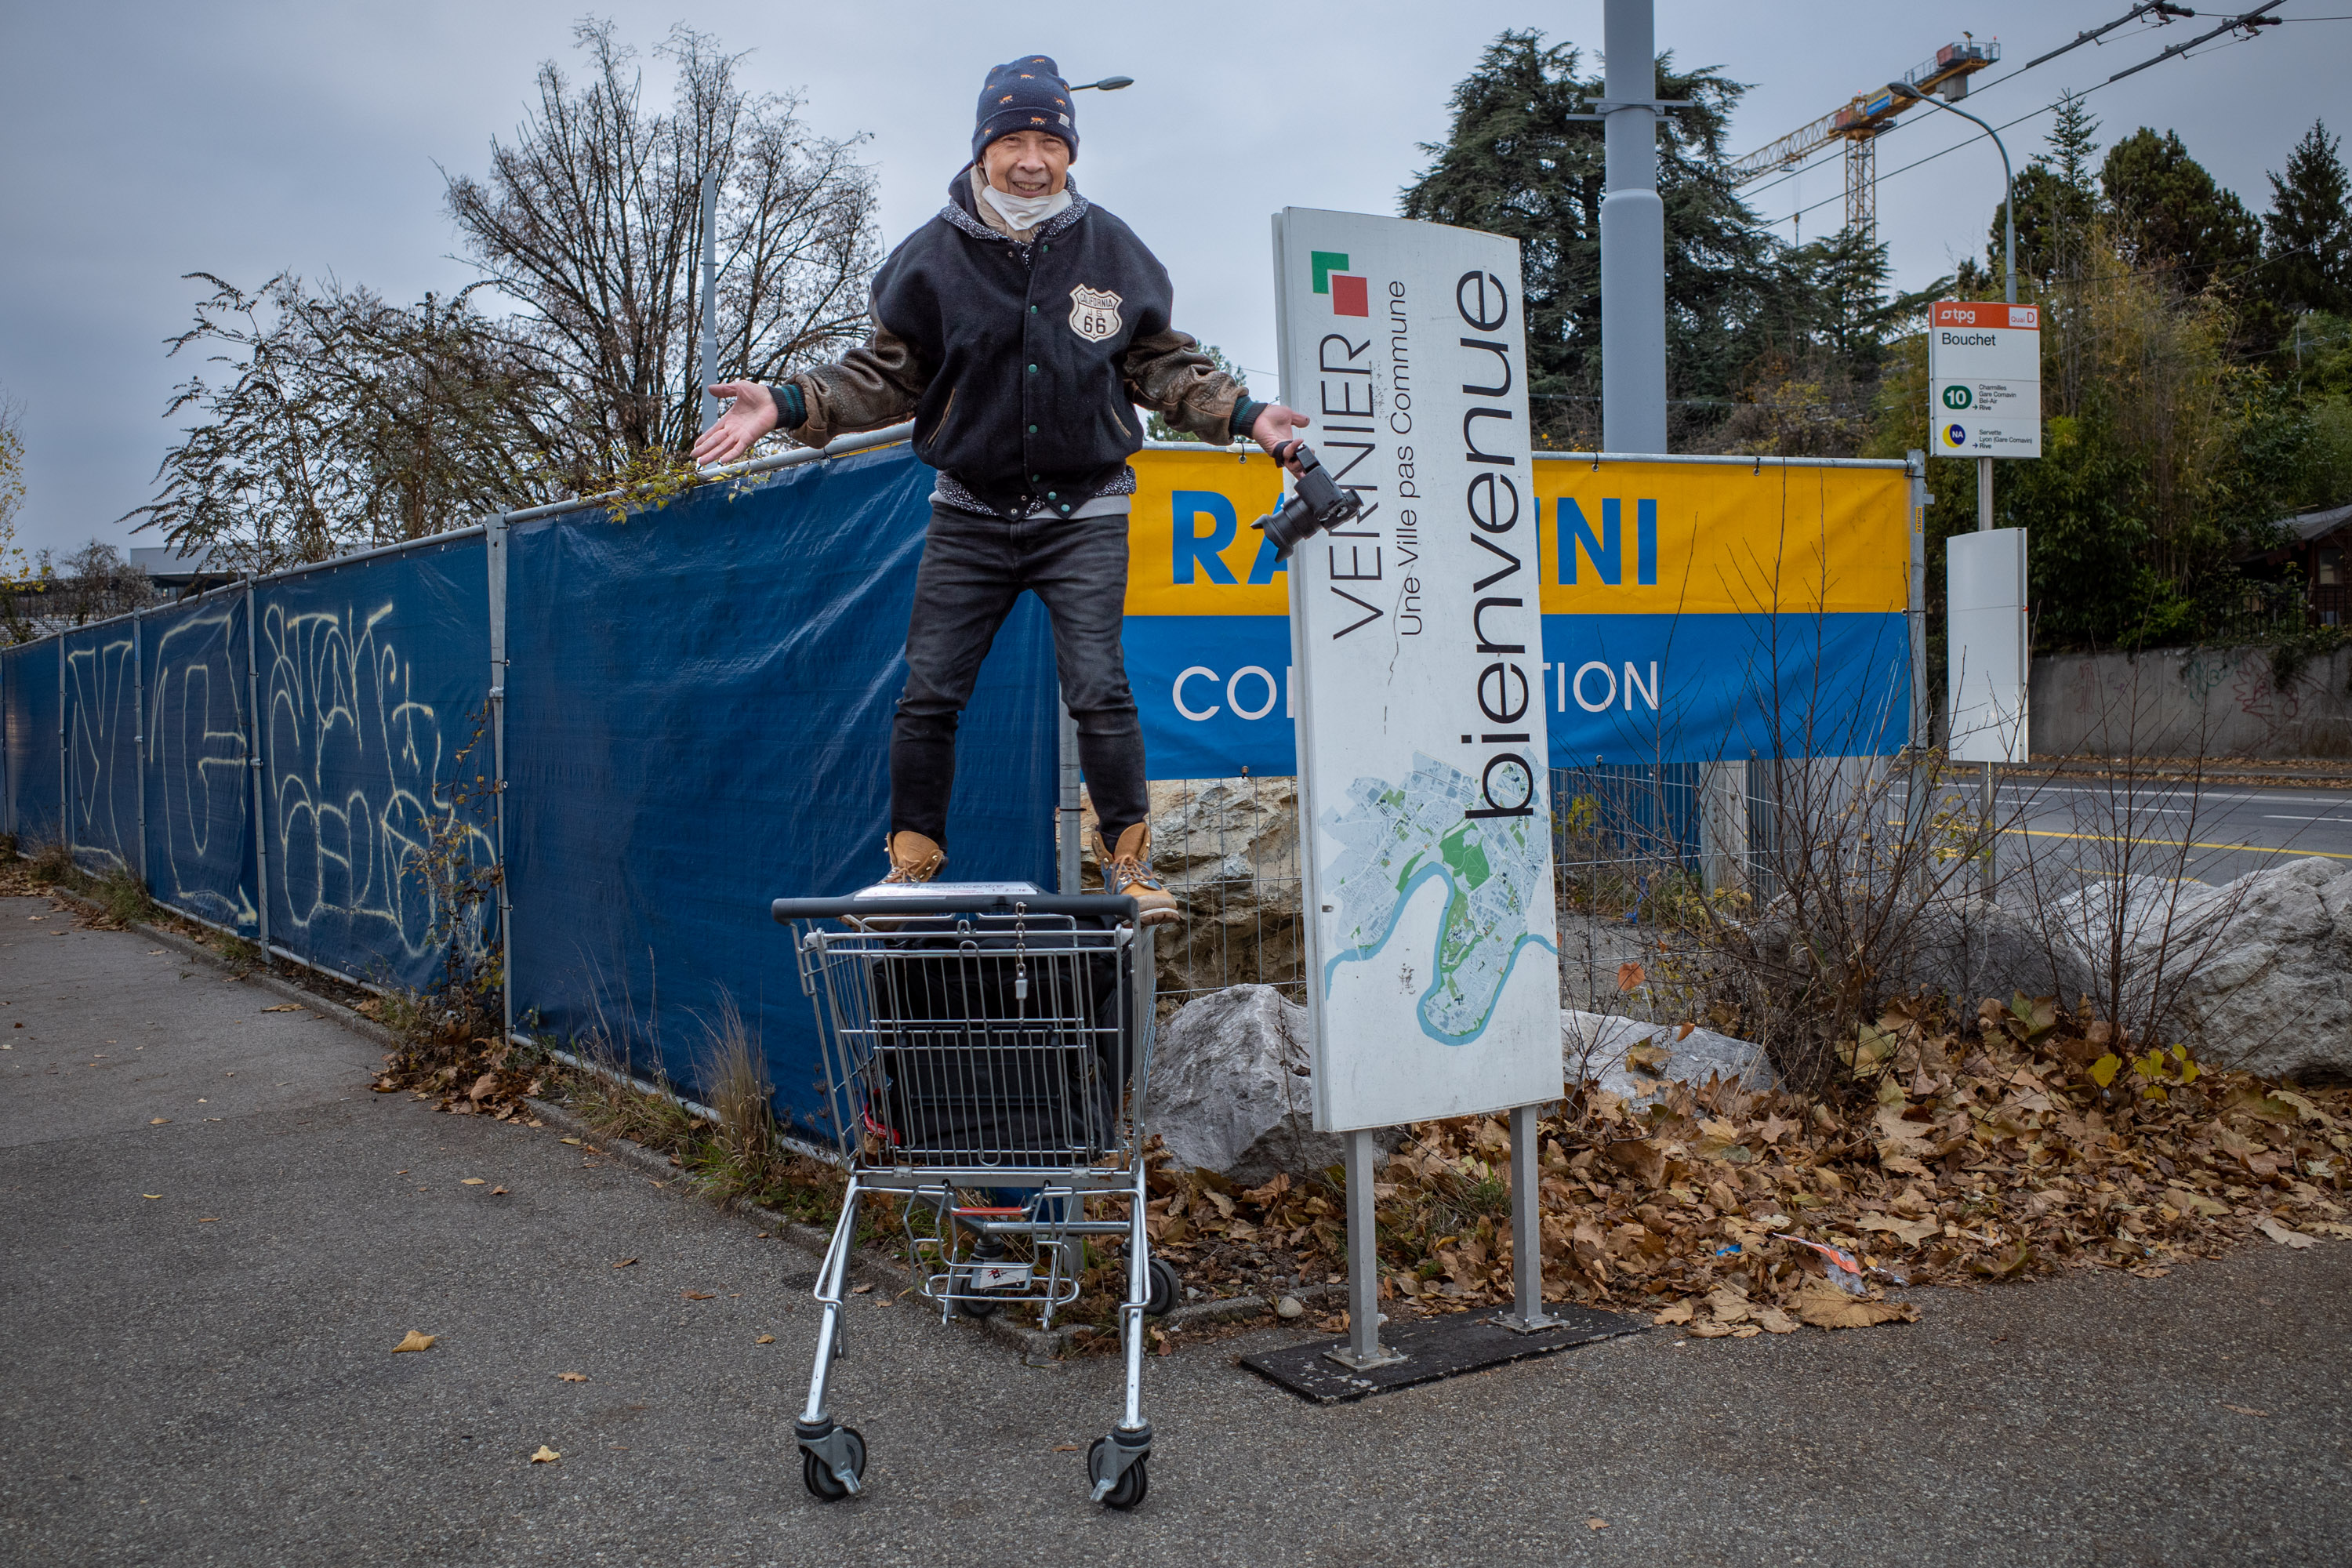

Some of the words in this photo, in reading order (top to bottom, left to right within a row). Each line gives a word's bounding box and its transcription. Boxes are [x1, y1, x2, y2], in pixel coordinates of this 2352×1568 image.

[1080, 293, 1112, 307] CALIFORNIA
[1953, 308, 1976, 324] tpg
[2010, 315, 2026, 324] Quai
[2027, 311, 2035, 324] D
[1084, 316, 1105, 334] 66
[1942, 332, 1996, 346] Bouchet
[1388, 281, 1413, 434] Commune
[1947, 390, 1967, 405] 10
[1951, 430, 1964, 439] NA
[1396, 445, 1421, 499] pas
[1396, 508, 1418, 567] Ville
[1456, 270, 1534, 819] bienvenue
[1401, 576, 1422, 636] Une
